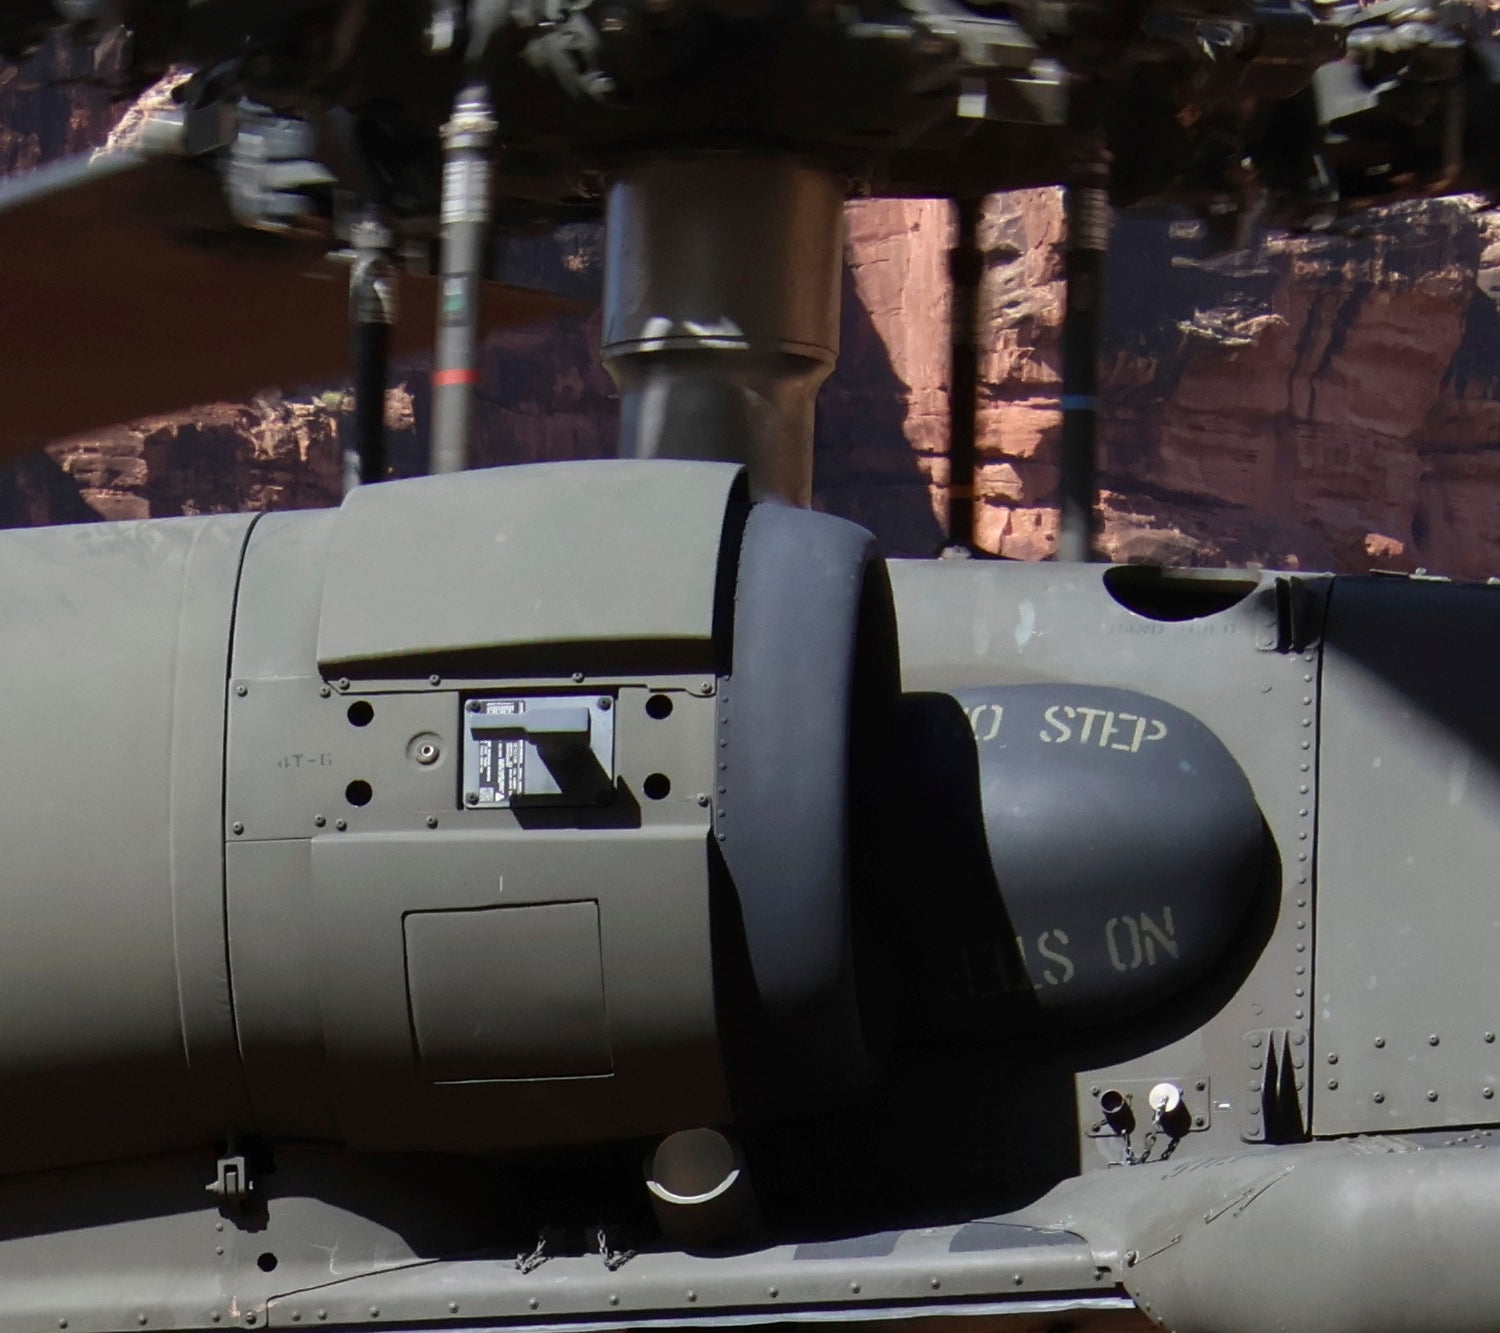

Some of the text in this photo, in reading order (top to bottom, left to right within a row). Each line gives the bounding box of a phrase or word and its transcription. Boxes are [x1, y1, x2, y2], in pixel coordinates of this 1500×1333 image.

[967, 704, 1168, 753] O STEP
[1104, 905, 1180, 972] ON
